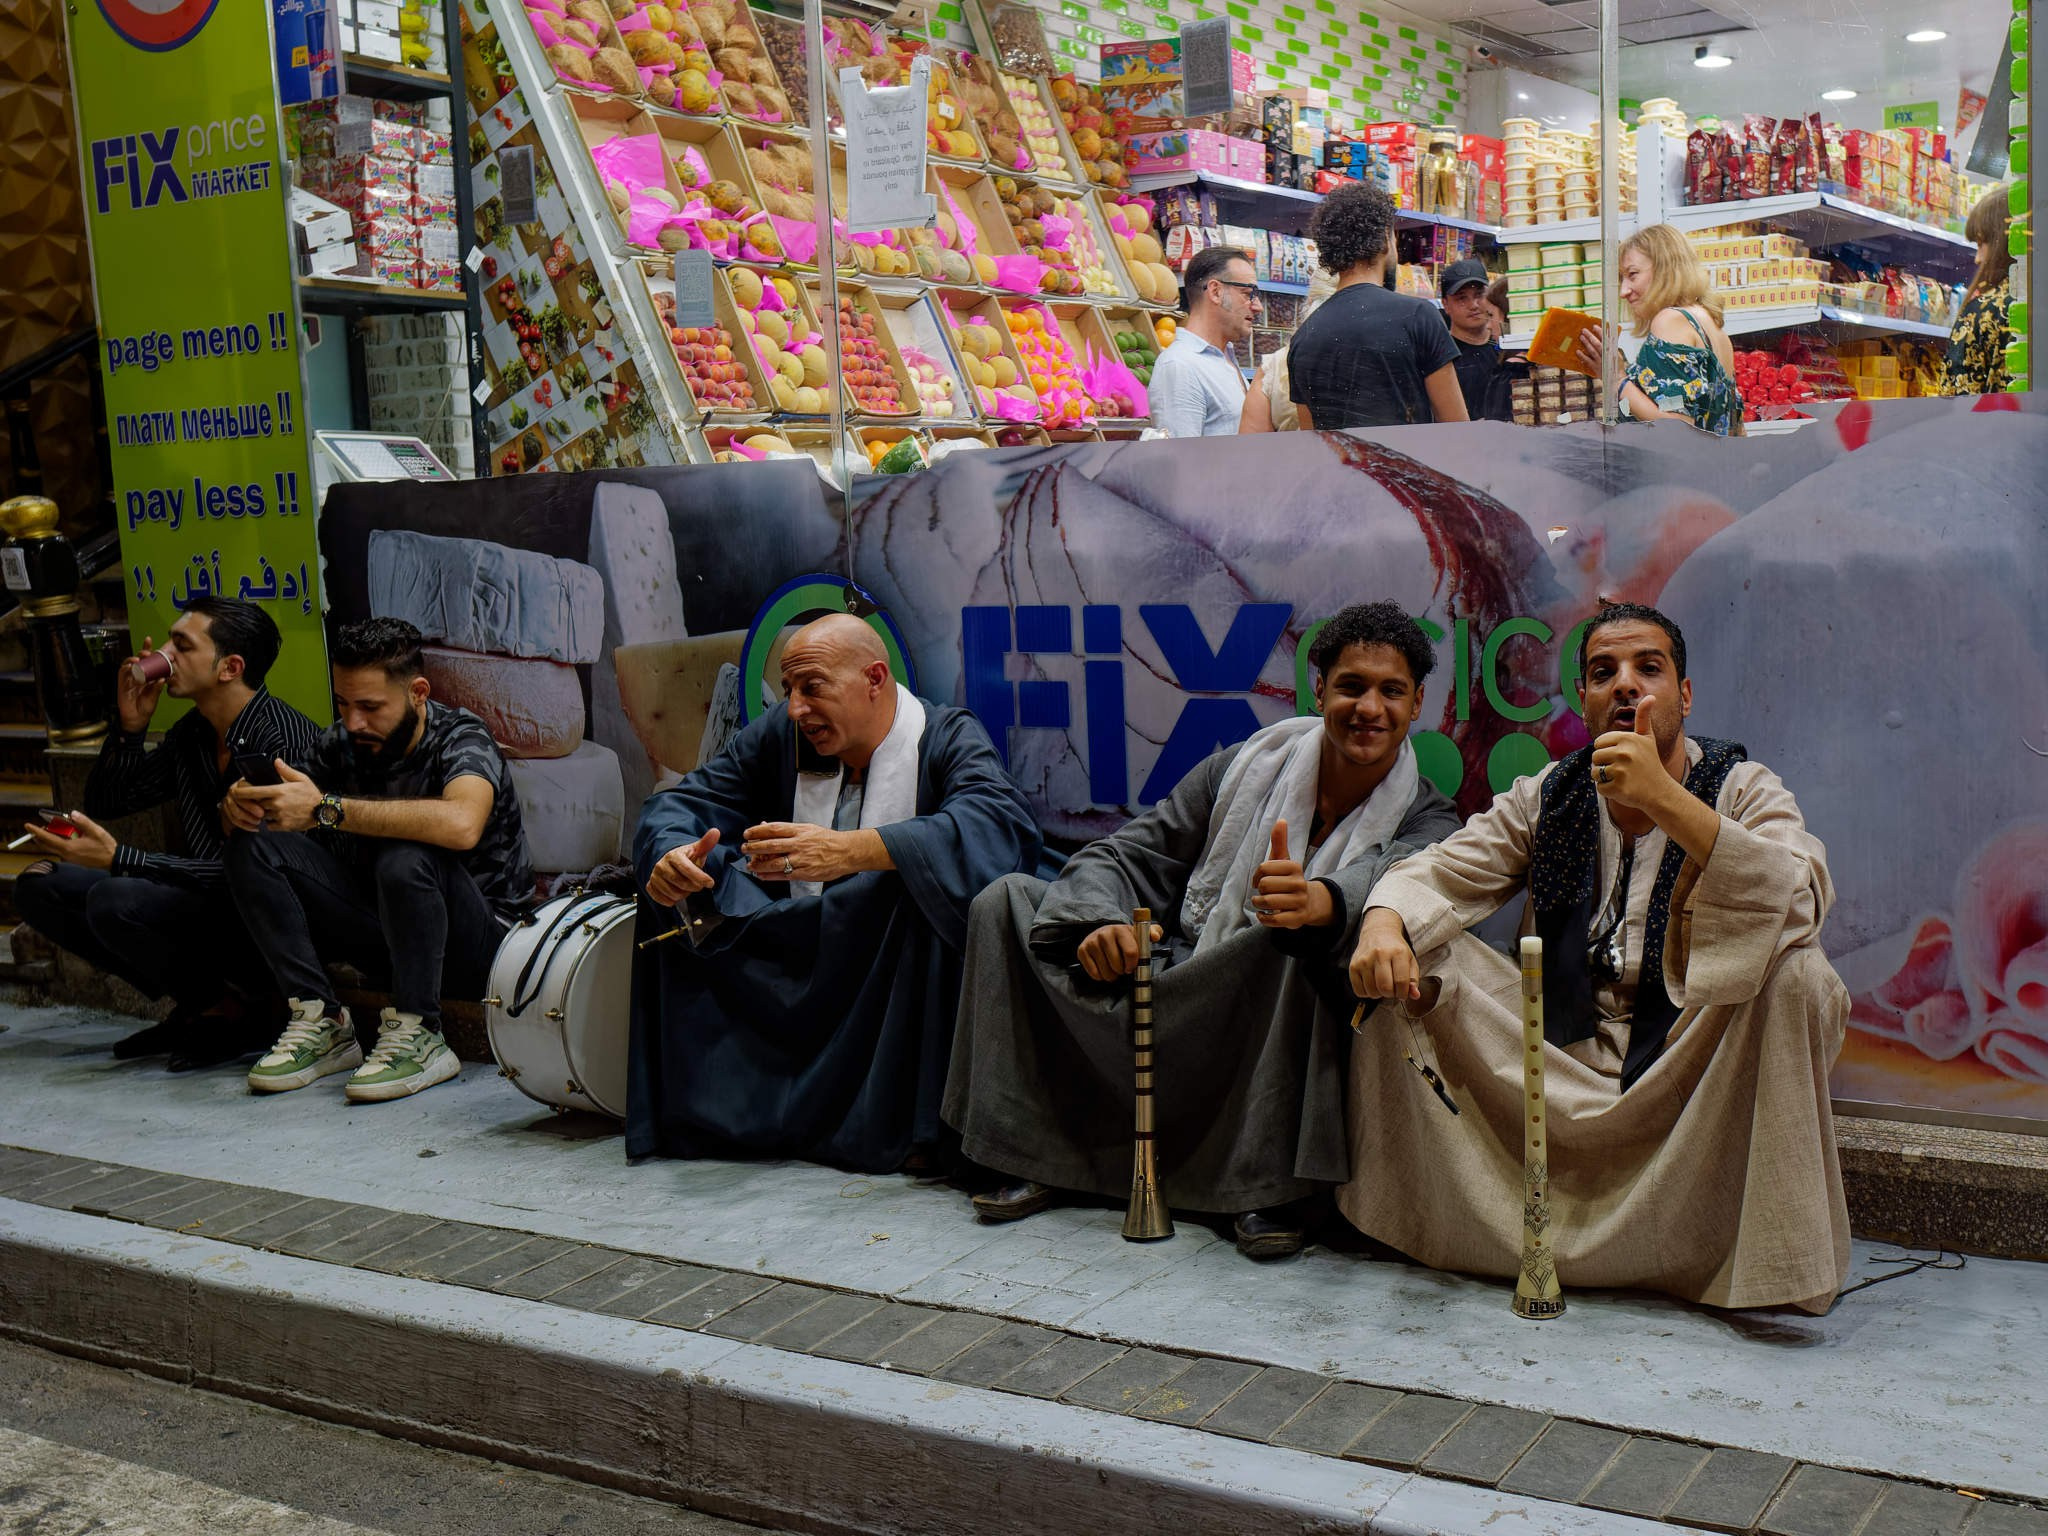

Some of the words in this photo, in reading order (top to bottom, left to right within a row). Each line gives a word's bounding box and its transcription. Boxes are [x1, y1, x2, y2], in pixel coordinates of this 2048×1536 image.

[187, 114, 266, 167] price
[192, 161, 271, 200] MARKET
[107, 330, 174, 374] page
[181, 323, 261, 359] meno
[268, 312, 288, 350] !!
[117, 410, 177, 446] плати
[181, 401, 272, 442] меньше
[277, 391, 293, 434] !!
[126, 487, 184, 532] pay
[193, 476, 266, 519] less
[274, 472, 299, 514] !!
[132, 565, 156, 602] !!
